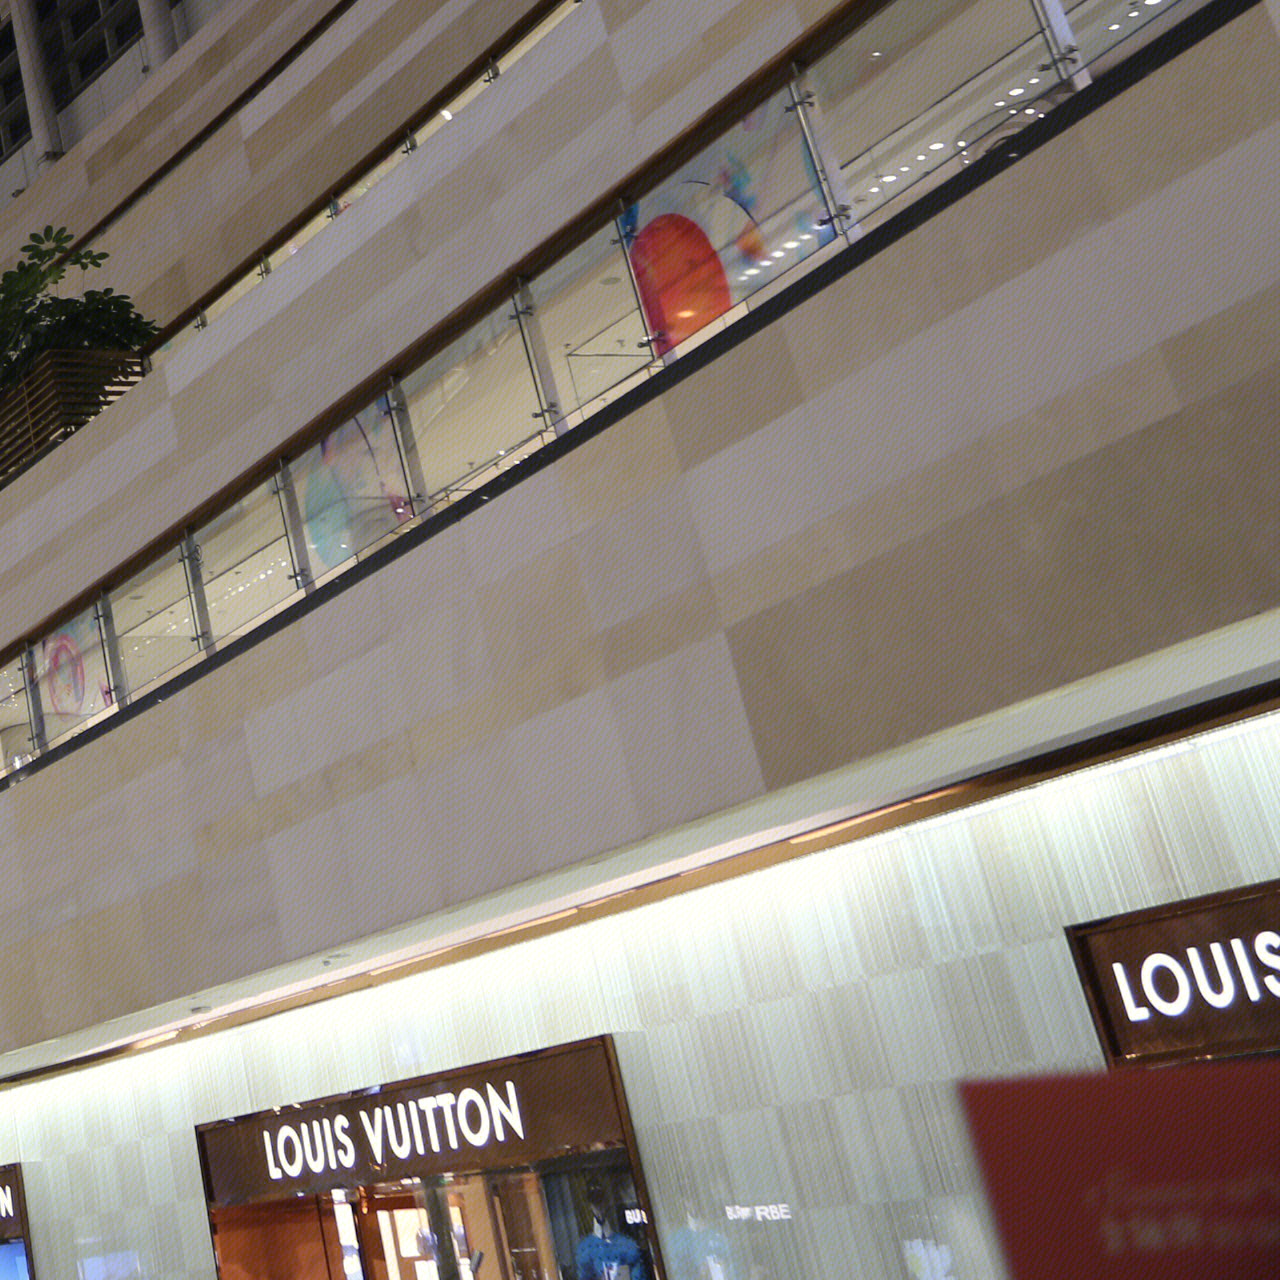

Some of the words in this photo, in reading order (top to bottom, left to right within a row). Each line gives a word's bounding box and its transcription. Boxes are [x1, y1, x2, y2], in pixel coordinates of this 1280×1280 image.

[1112, 930, 1280, 1023] LOUIS
[263, 1114, 355, 1180] LOUIS
[359, 1080, 525, 1165] VUITTON
